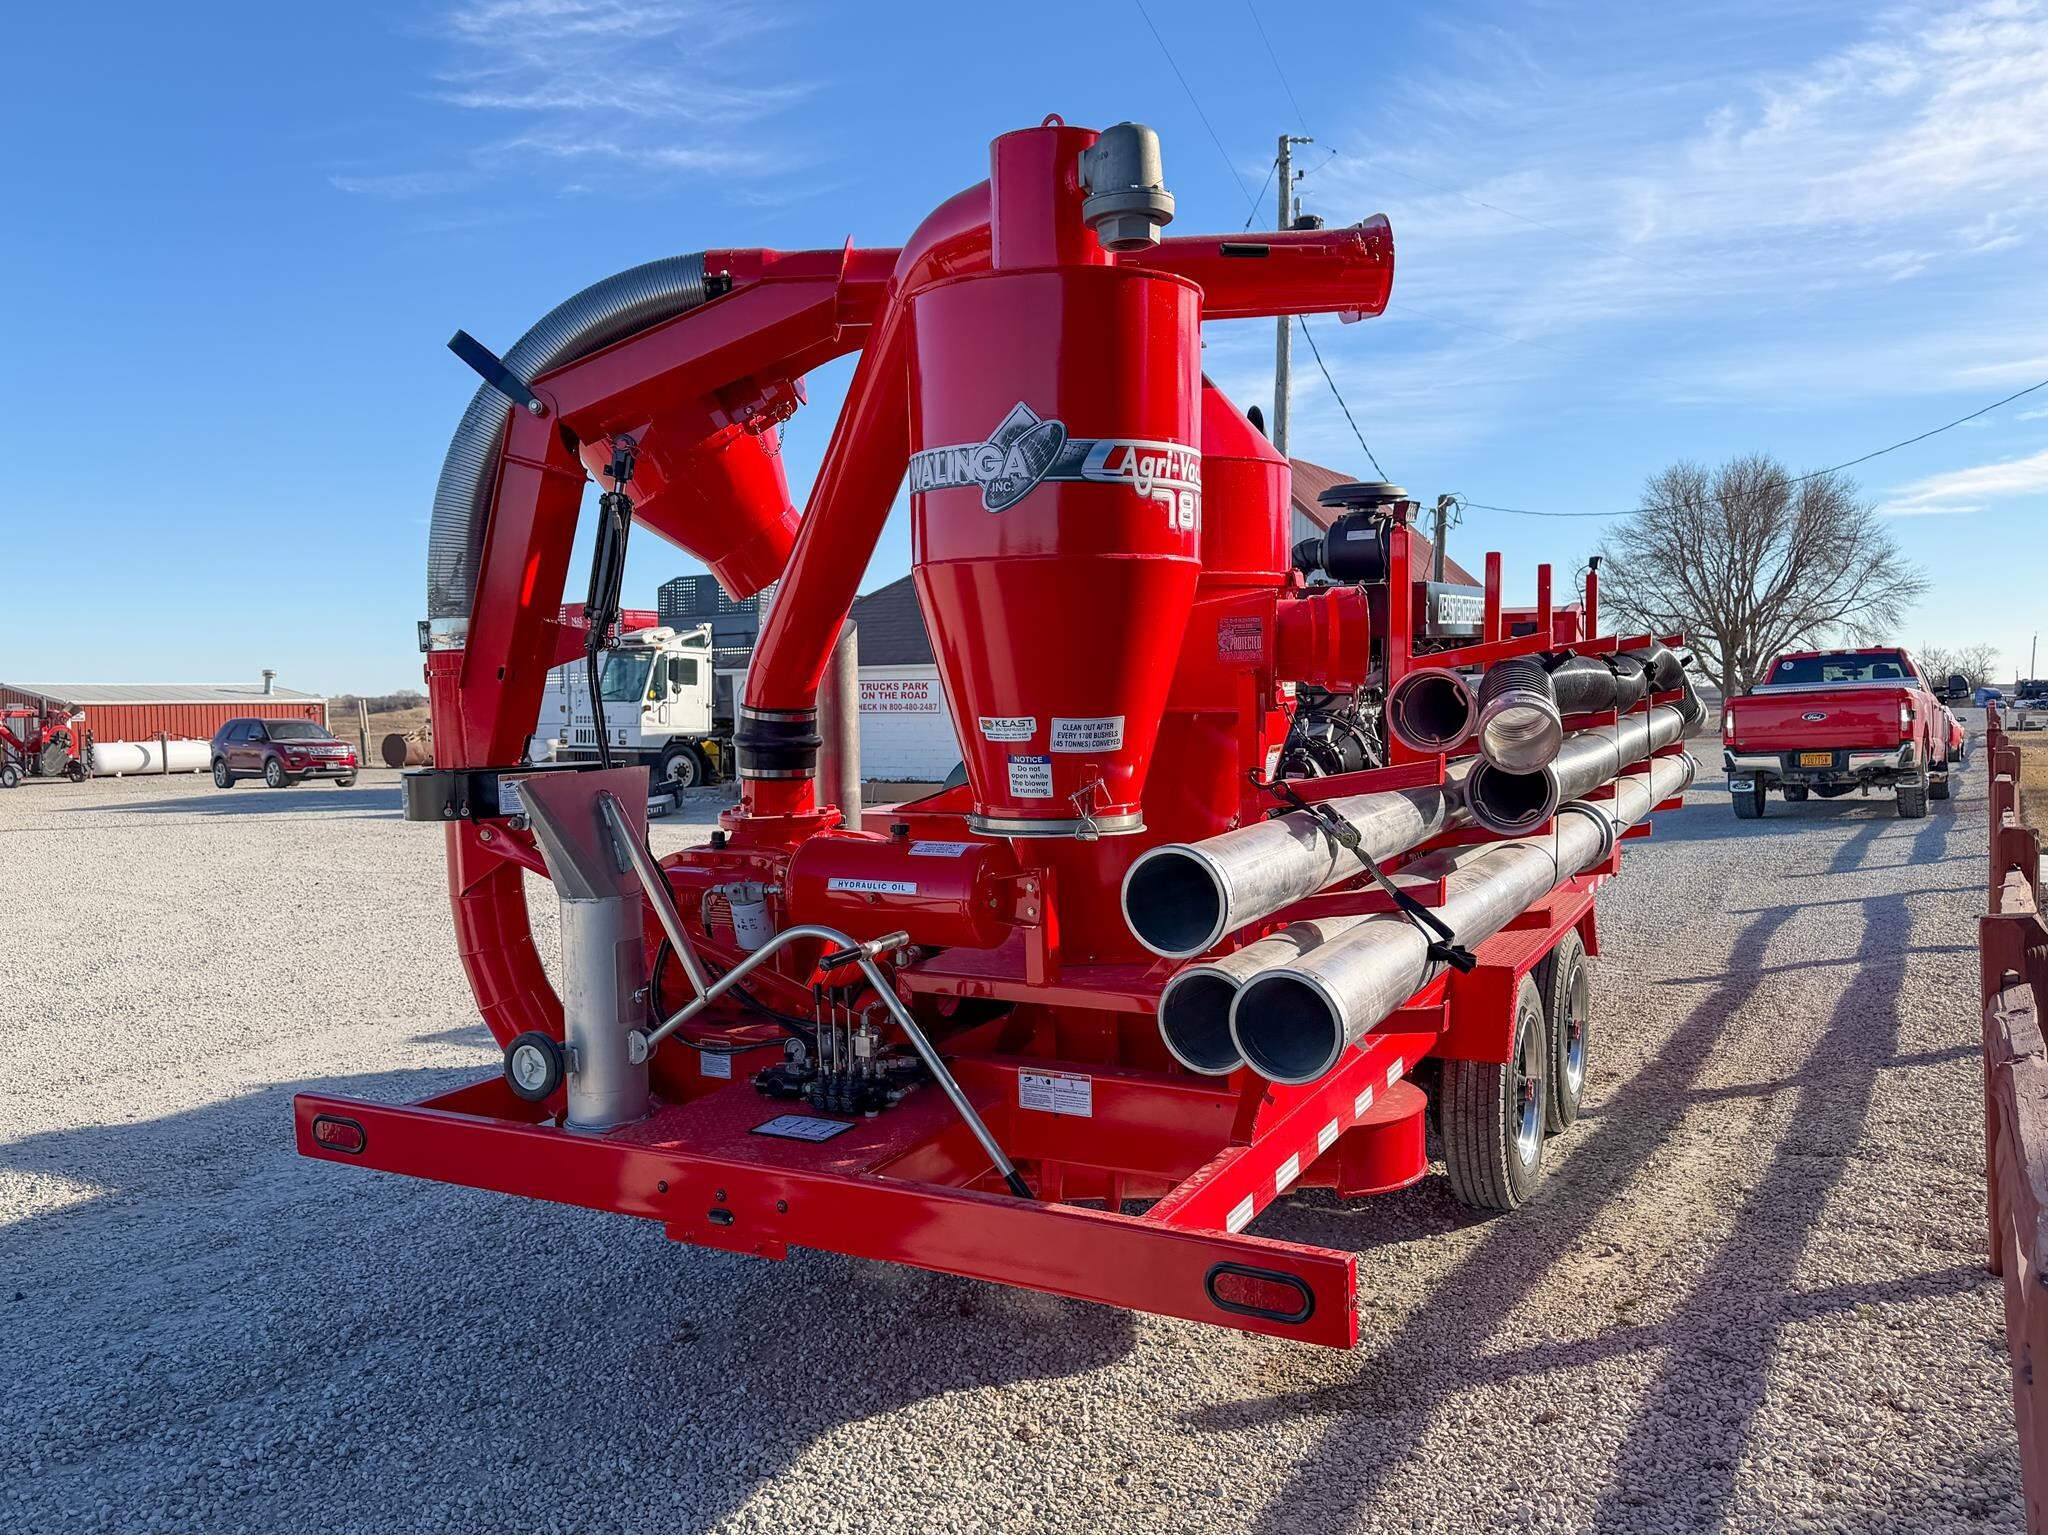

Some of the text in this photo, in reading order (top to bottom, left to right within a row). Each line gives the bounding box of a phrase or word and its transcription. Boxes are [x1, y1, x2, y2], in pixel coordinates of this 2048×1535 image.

[910, 444, 1031, 489] WALINGA
[991, 482, 1014, 493] INC.
[1230, 635, 1262, 650] PROTECTED
[860, 682, 928, 690] TRUCKS PARK
[901, 691, 928, 699] ROAD
[995, 719, 1033, 727] KEAST
[1062, 723, 1082, 731] CLEAN
[1083, 723, 1095, 731] OUT
[1093, 730, 1118, 739] BUSHELS
[1065, 740, 1091, 748] TONNES)
[1092, 738, 1121, 747] CONVEYED
[838, 881, 906, 891] HYDRAULIC OIL
